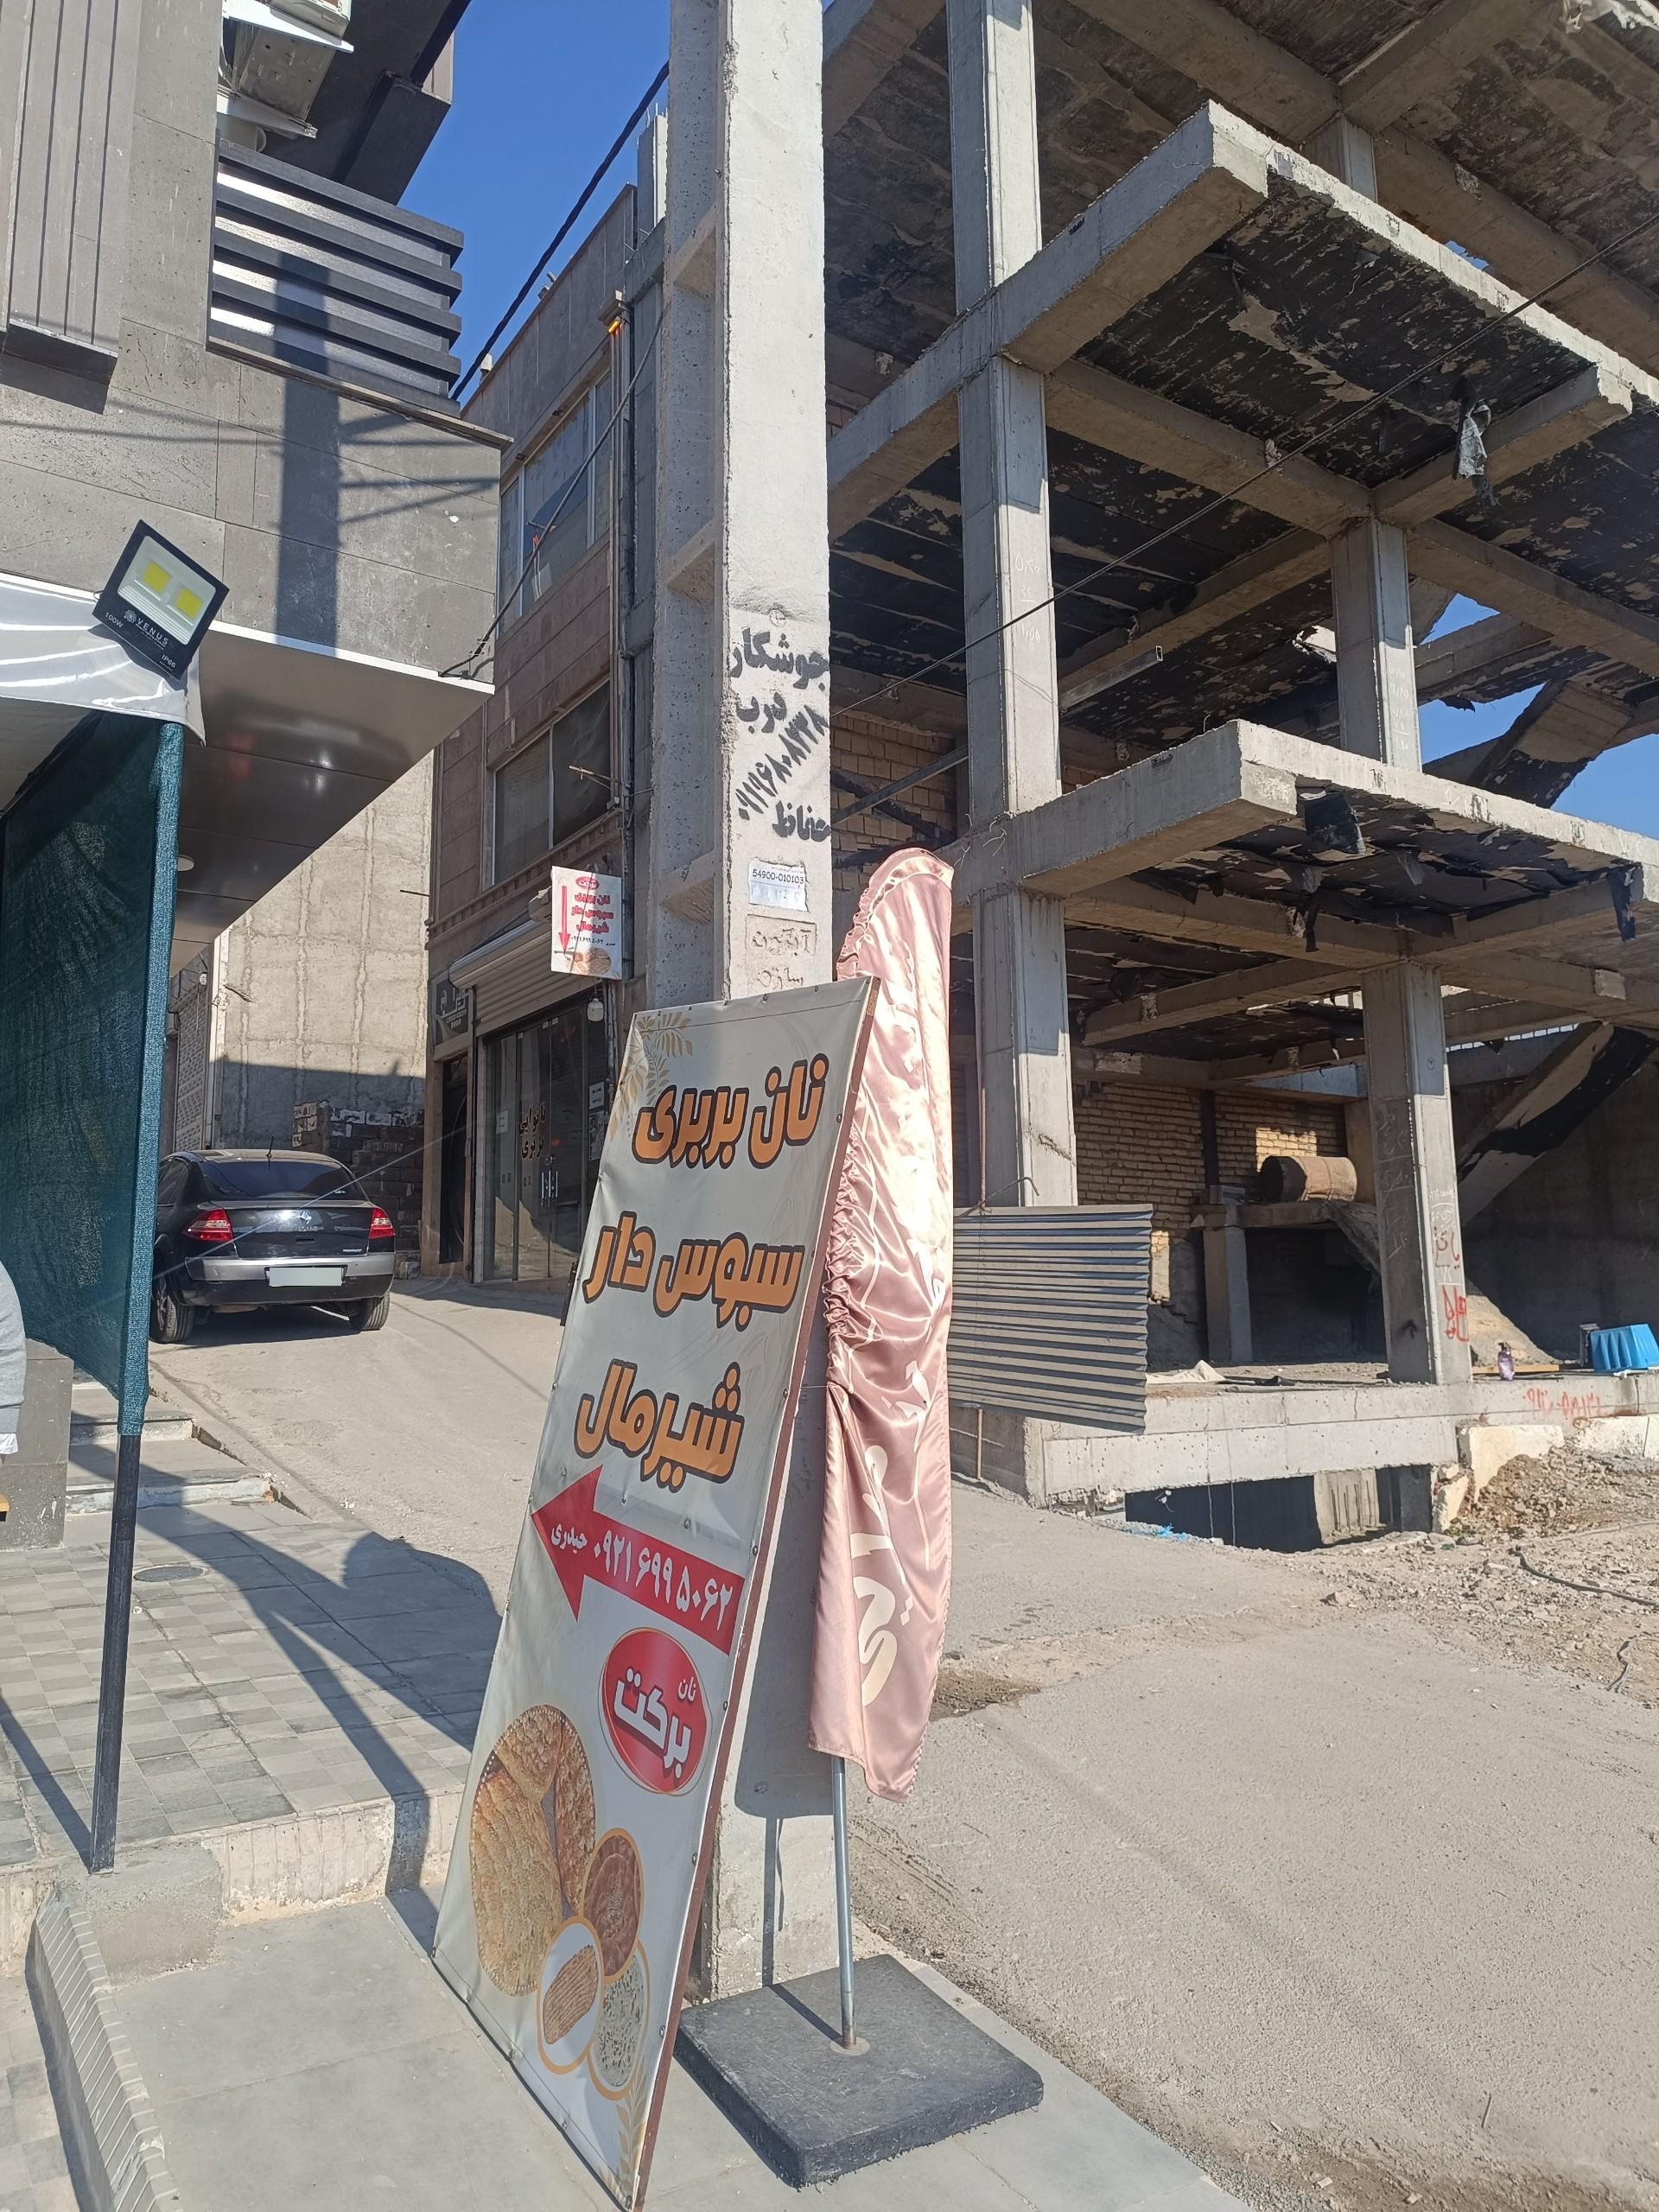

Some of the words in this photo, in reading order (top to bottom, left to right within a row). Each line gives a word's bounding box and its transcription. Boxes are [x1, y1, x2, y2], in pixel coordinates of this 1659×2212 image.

[105, 612, 124, 628] 100W
[137, 618, 169, 645] VENUS
[161, 654, 176, 668] IP66
[736, 691, 787, 734] درب
[772, 800, 830, 842] حفاظ
[752, 868, 804, 884] 54900-010103
[632, 1084, 750, 1170] بربری
[748, 1053, 829, 1169] نان
[583, 1211, 656, 1304] دار
[654, 1232, 805, 1332] سبوس
[575, 1359, 744, 1493] شیرمال
[550, 1523, 588, 1554] حیدری
[594, 1529, 632, 1583] ۰۹۲۱
[635, 1547, 673, 1604] ۶۹۹
[676, 1566, 734, 1631] ۵۰۶۲
[678, 1675, 696, 1702] نان
[613, 1668, 691, 1779] برکت
